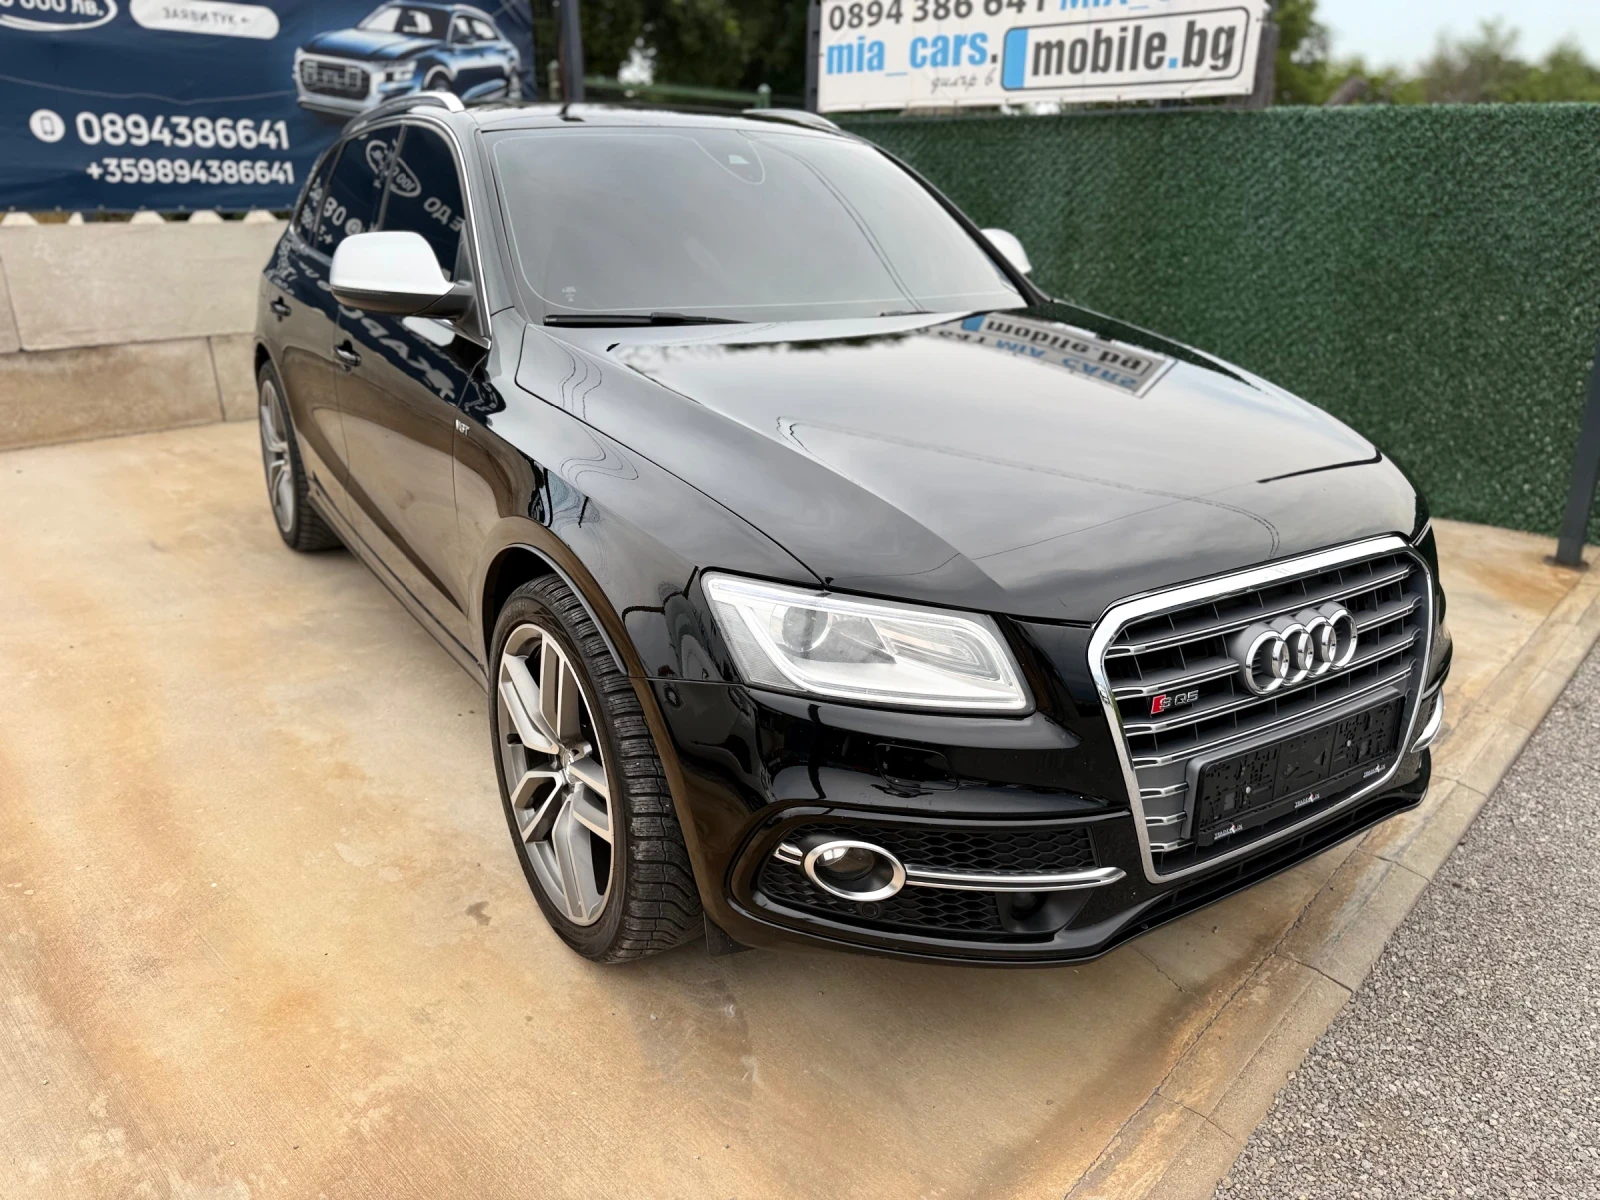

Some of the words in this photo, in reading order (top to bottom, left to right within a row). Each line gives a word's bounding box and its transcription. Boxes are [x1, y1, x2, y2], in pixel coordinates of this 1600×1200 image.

[829, 0, 903, 31] 0894
[913, 0, 973, 22] 386
[1031, 20, 1237, 77] mobile.bg
[75, 111, 290, 150] 0894386641
[86, 158, 294, 184] +359894386641
